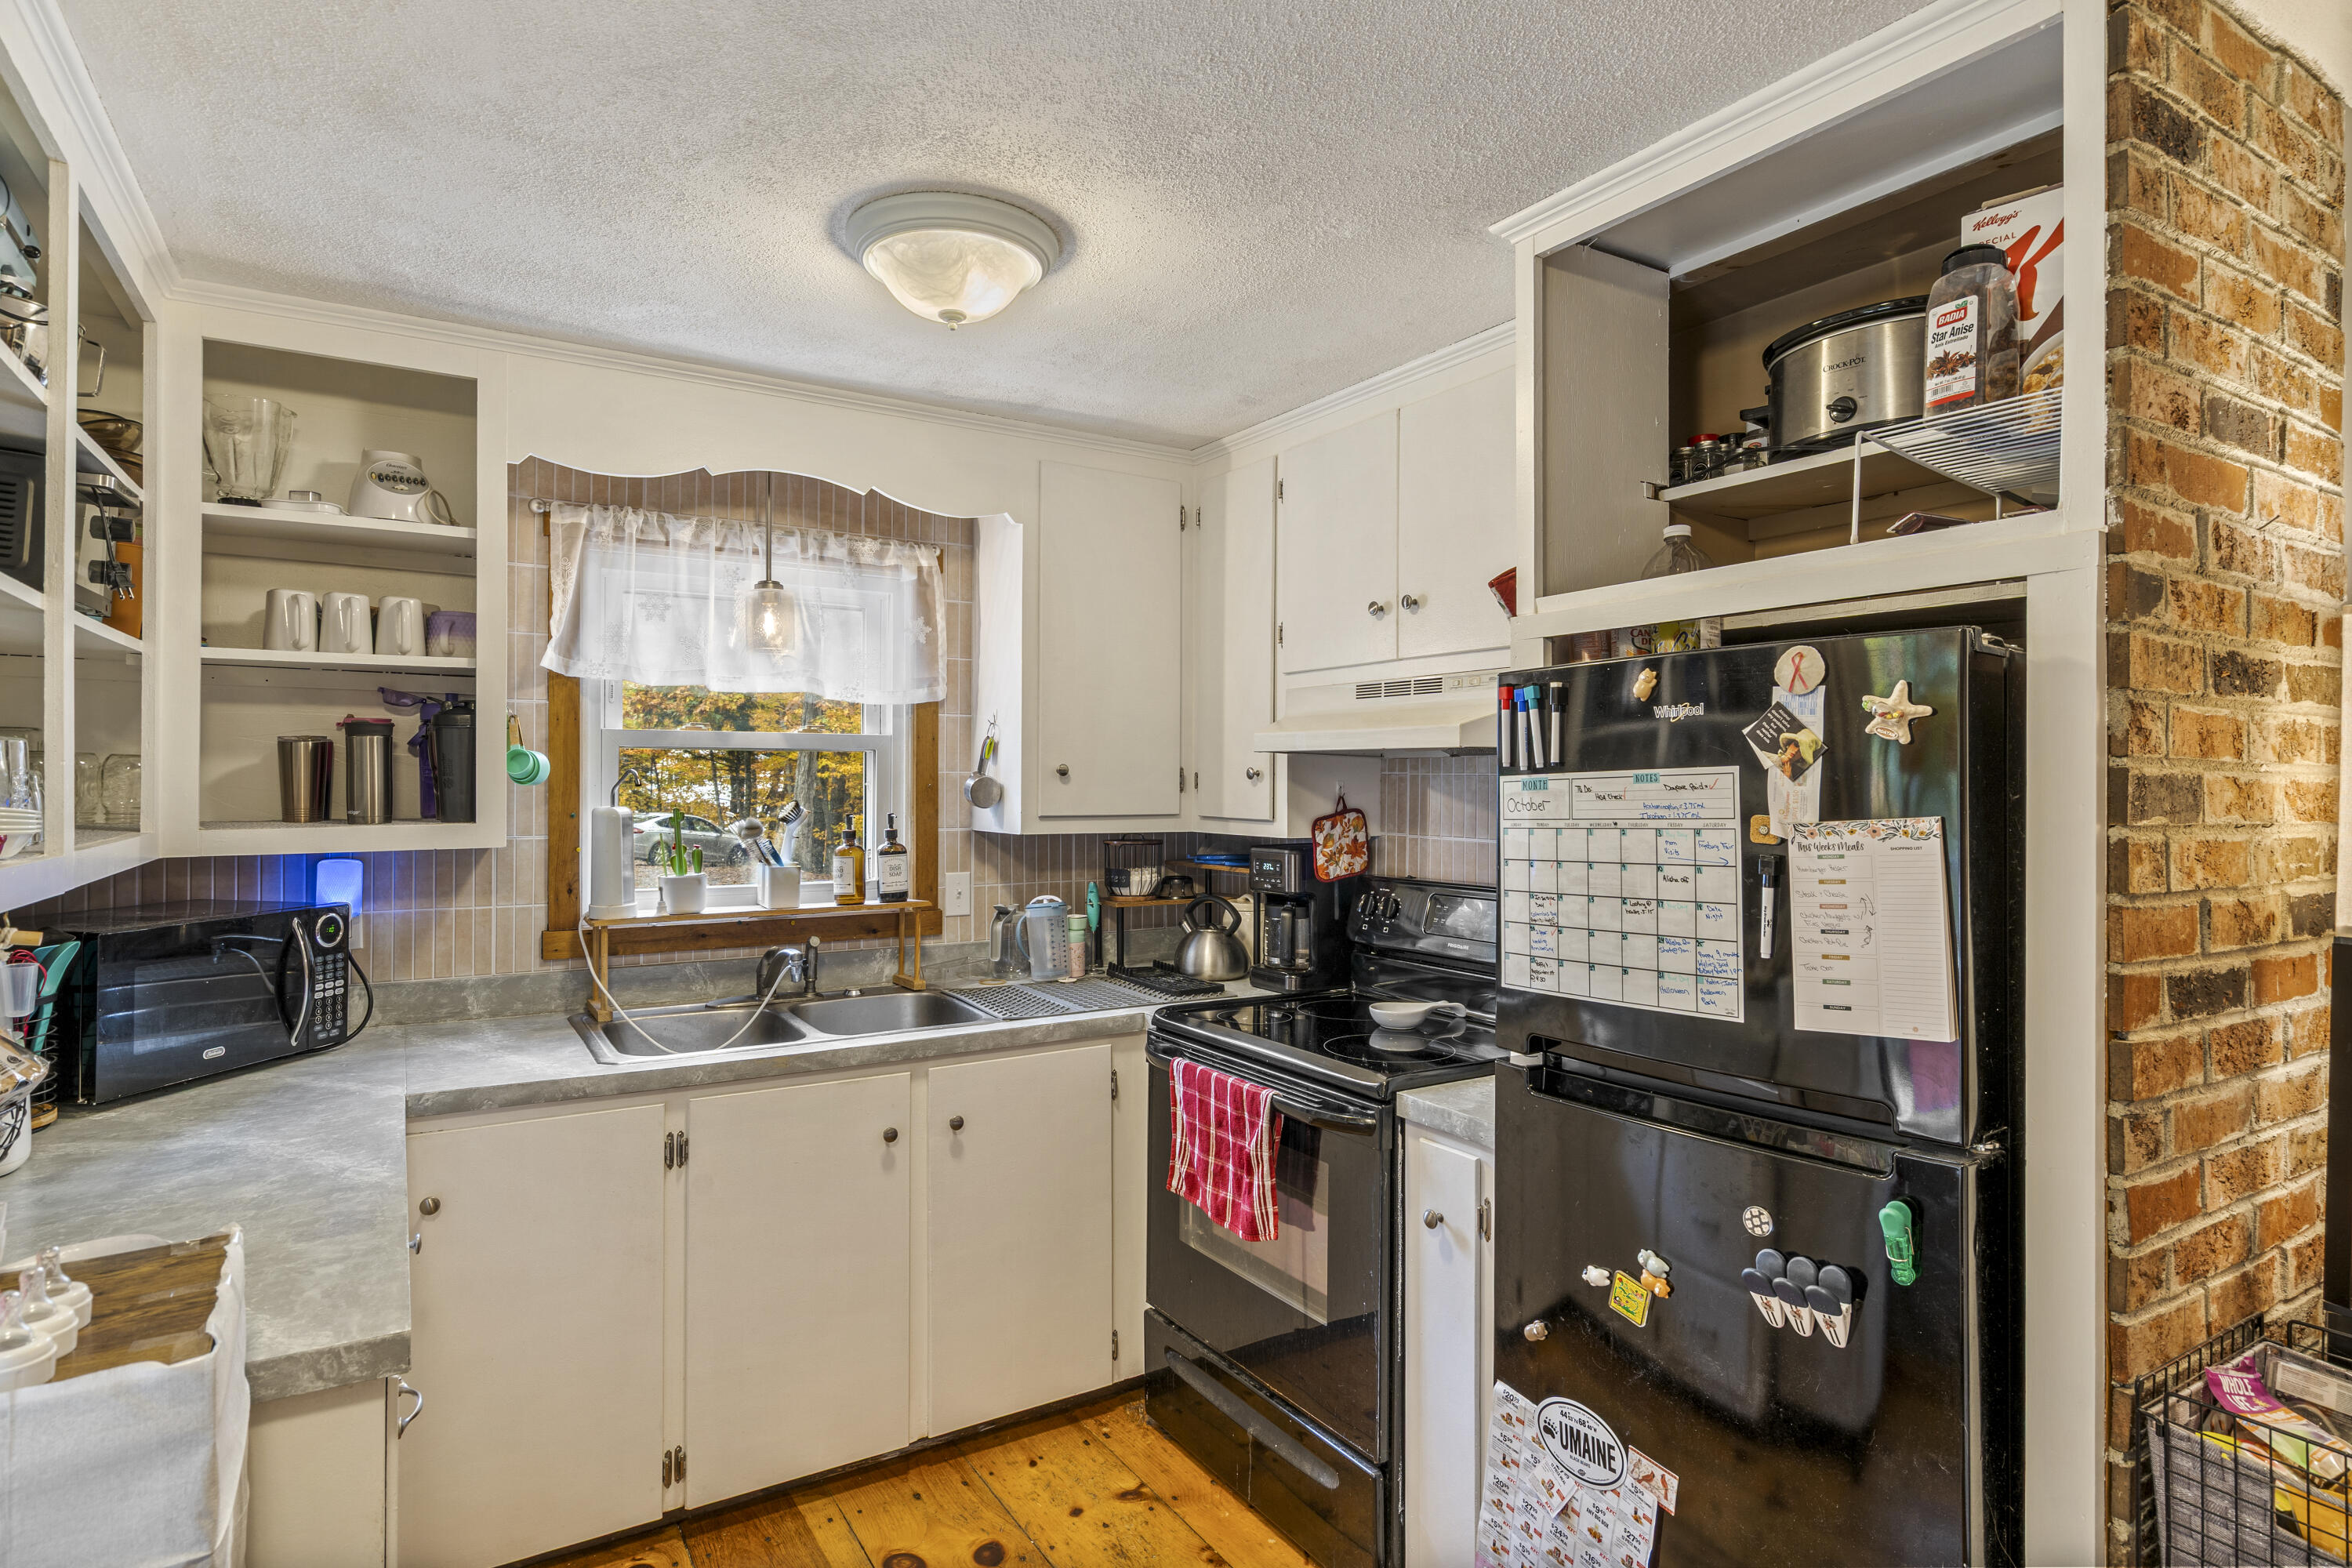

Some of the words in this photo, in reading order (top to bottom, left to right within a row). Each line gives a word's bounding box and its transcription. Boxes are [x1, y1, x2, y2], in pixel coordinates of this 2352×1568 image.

[1972, 210, 2020, 231] Kellogg's
[1978, 232, 2017, 245] ECIAL
[1938, 309, 1965, 326] BADIA
[1931, 330, 1948, 344] Star
[1949, 323, 1974, 339] Anise
[1630, 628, 1650, 637] CAN
[1653, 702, 1704, 720] Whirlpool
[1778, 710, 1791, 721] Alcohol
[1771, 710, 1783, 720] doesn't
[1782, 720, 1791, 728] solve
[1761, 728, 1772, 739] neither
[1635, 774, 1659, 783] NOTES
[1523, 779, 1548, 791] MONTH
[1507, 797, 1551, 812] October
[1796, 840, 1812, 853] This
[1813, 841, 1837, 852] Weeks
[1837, 840, 1865, 852] Meals
[1705, 913, 1724, 922] Night
[2218, 1374, 2256, 1396] WHOLE
[2225, 1394, 2255, 1412] LIFE
[1559, 1420, 1617, 1475] UMAINE
[1507, 1475, 1517, 1486] KFC
[1537, 1500, 1546, 1509] KFC
[1606, 1506, 1617, 1516] KFC
[1567, 1525, 1577, 1536] KFC
[1639, 1533, 1650, 1544] KFC
[1599, 1552, 1610, 1563] KFC
